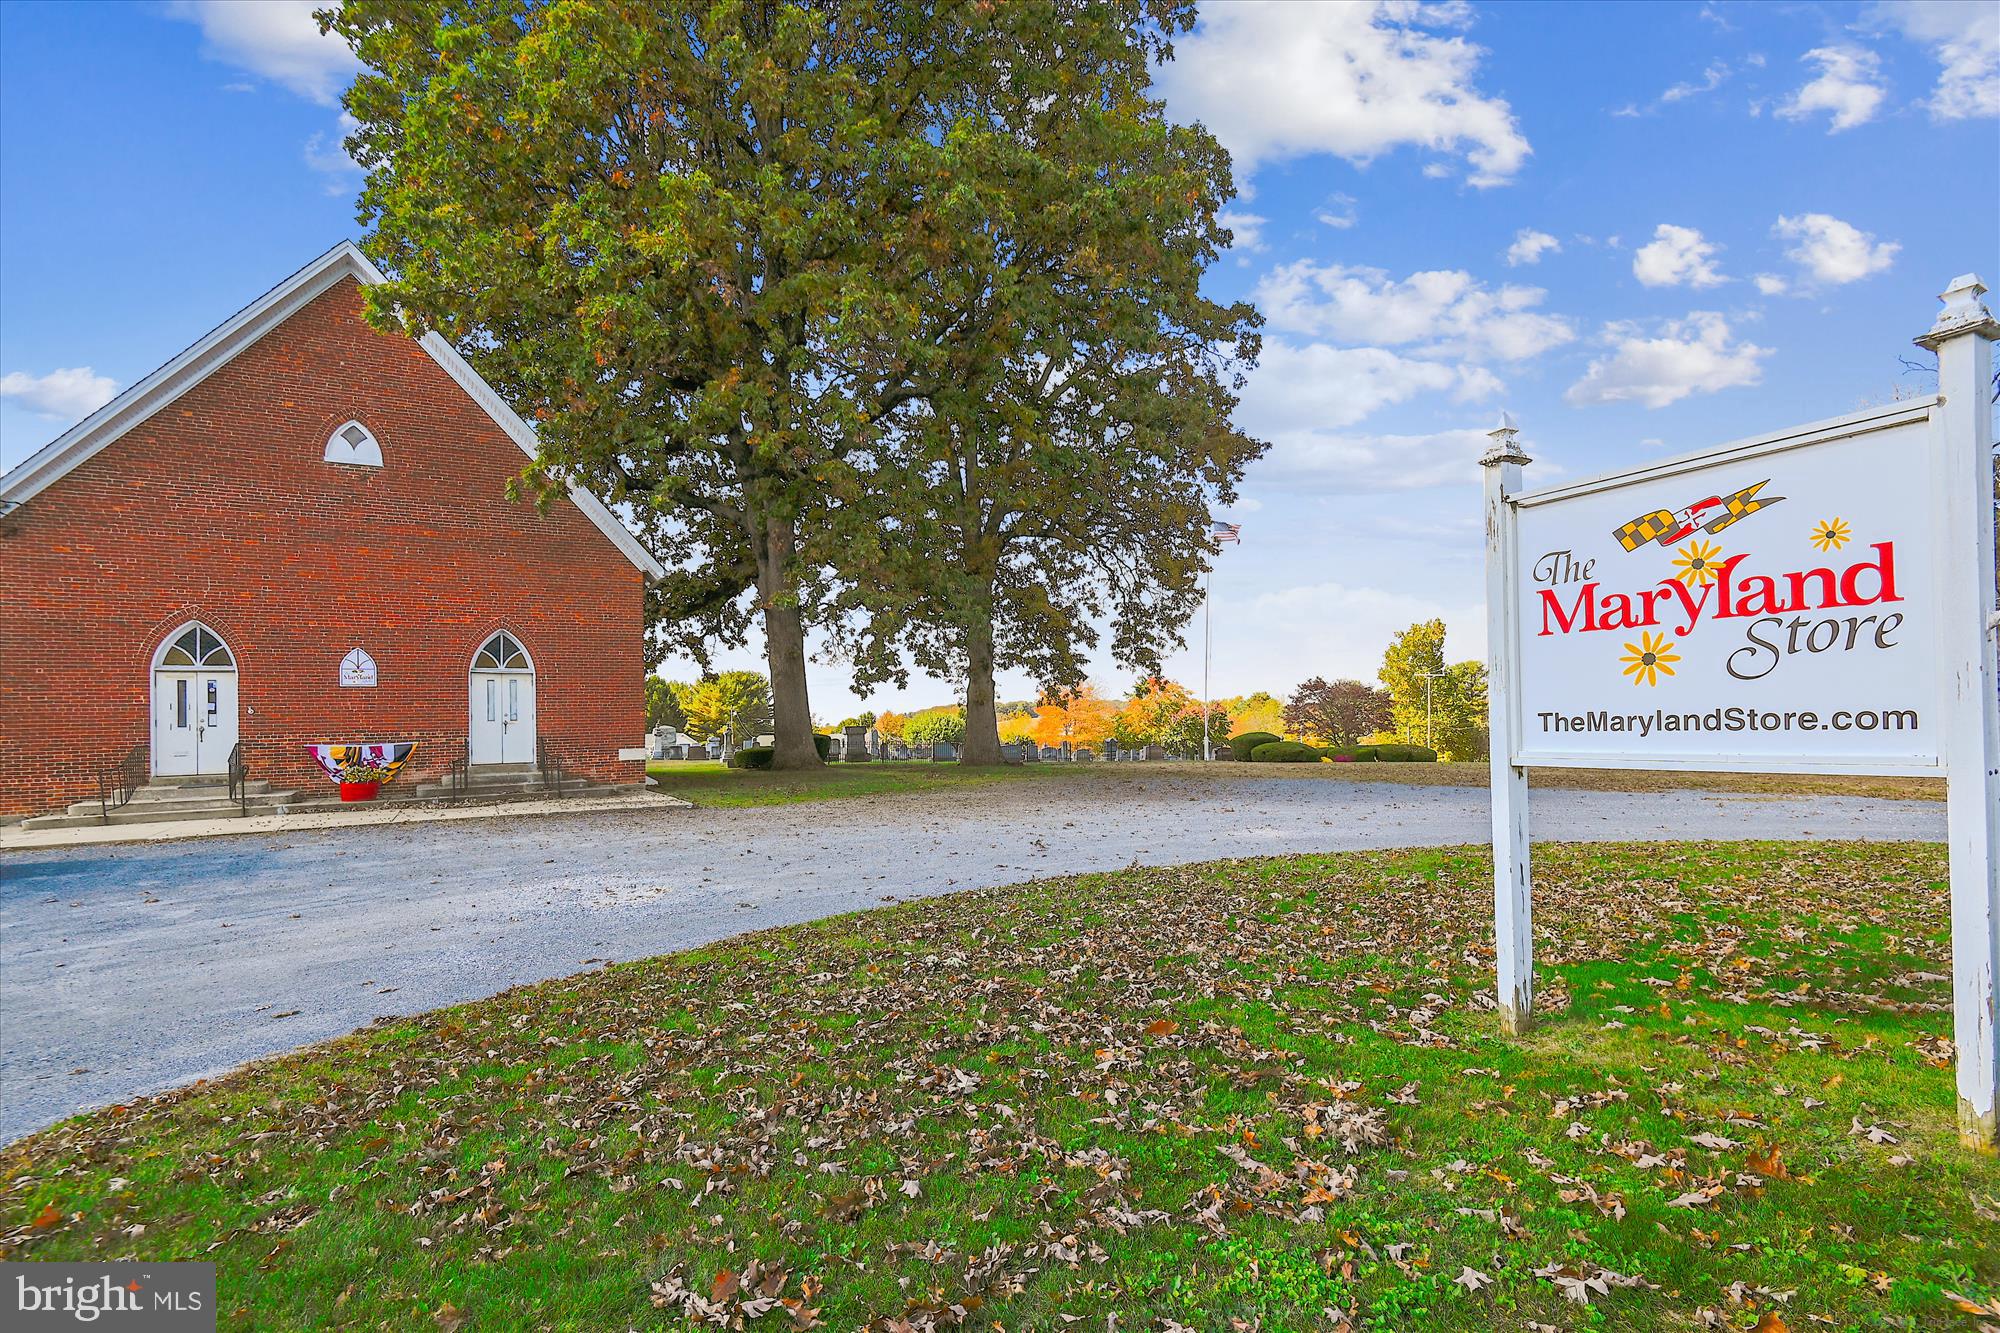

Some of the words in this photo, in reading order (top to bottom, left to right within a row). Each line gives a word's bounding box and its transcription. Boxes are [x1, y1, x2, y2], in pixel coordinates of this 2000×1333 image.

[1532, 549, 1596, 586] The
[1536, 541, 1904, 637] Maryland
[1726, 612, 1904, 681] Store
[1537, 707, 1918, 738] TheMarylandStore.com
